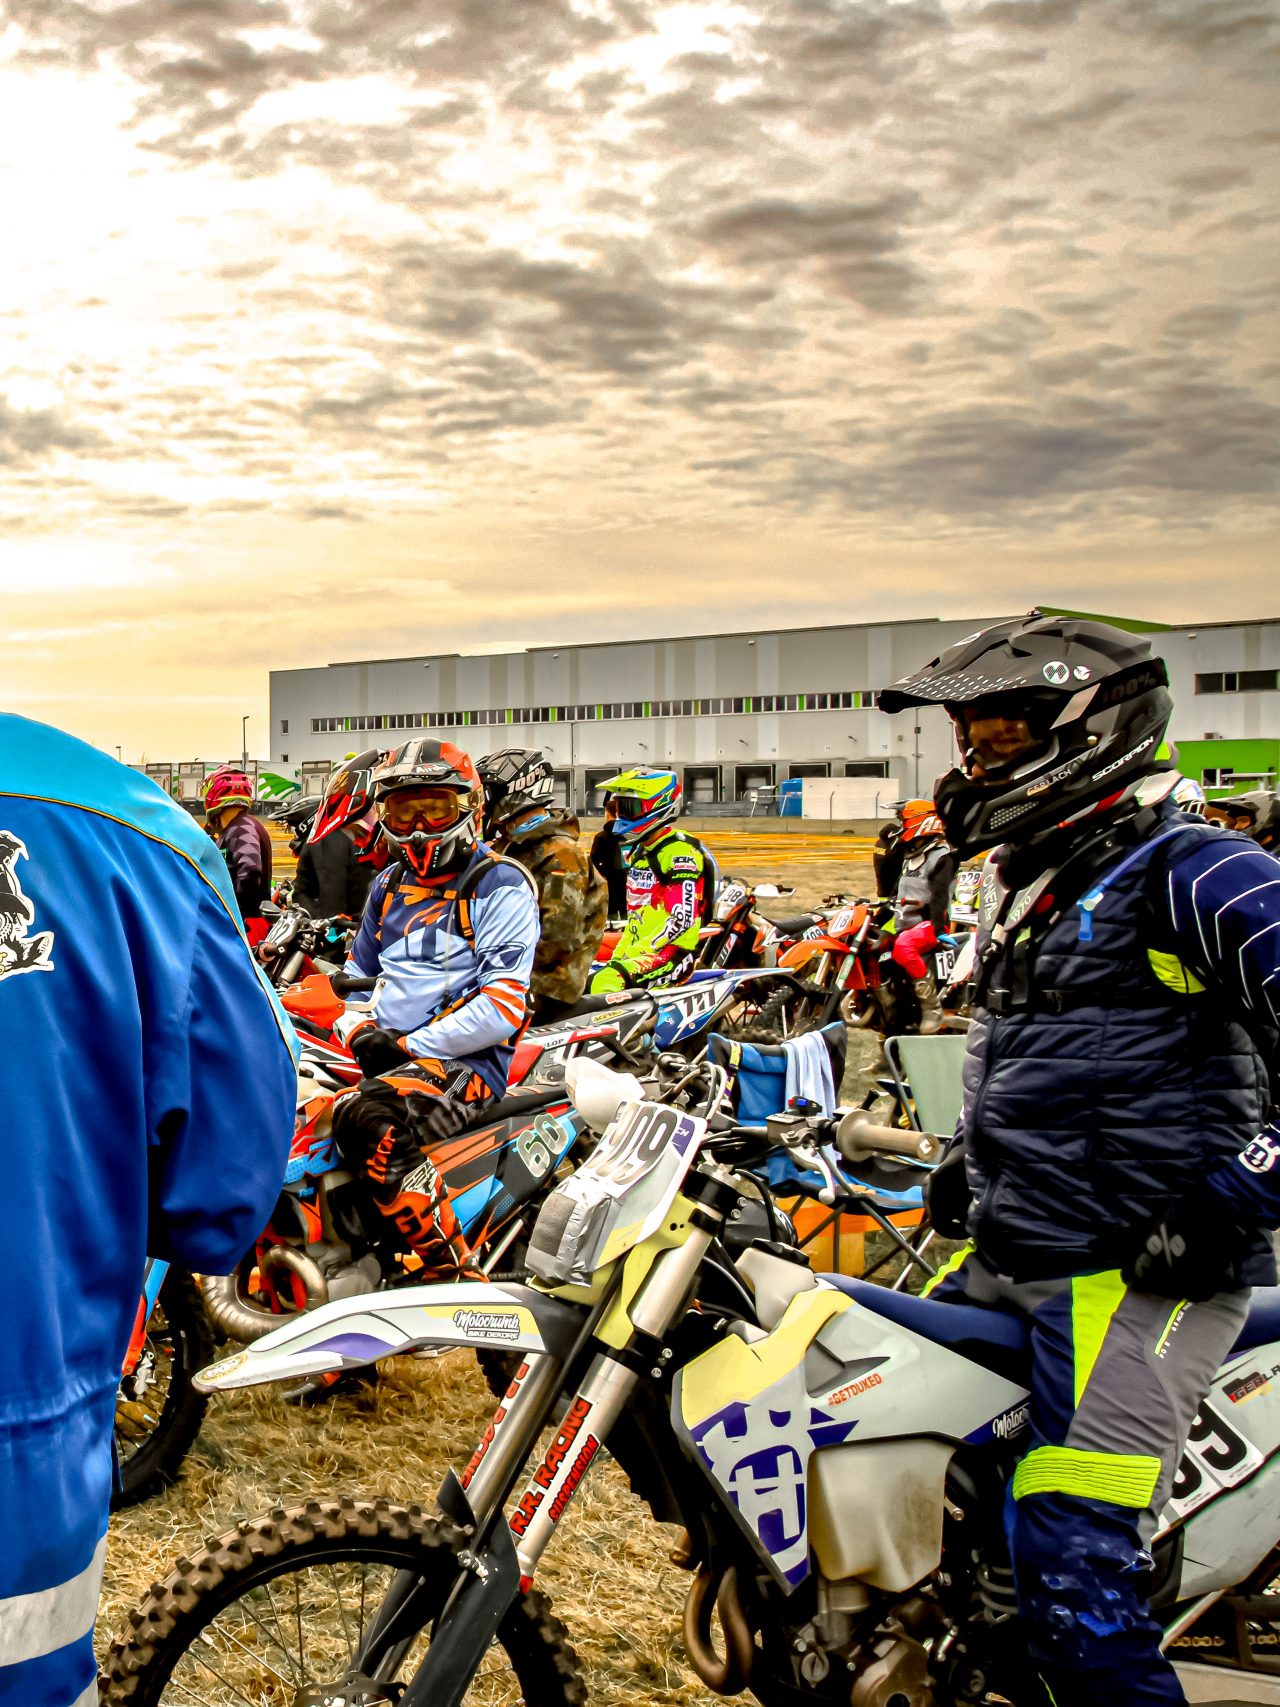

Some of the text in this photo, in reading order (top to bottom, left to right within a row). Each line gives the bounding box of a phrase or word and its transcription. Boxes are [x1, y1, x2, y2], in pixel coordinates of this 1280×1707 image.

[1091, 735, 1155, 783] SCORPION
[507, 764, 547, 795] 100%
[1026, 768, 1073, 797] GERLACH
[667, 909, 685, 941] AUTO
[516, 1113, 569, 1178] 60
[453, 1309, 520, 1333] Motocrumb
[486, 1331, 519, 1340] DEKORE
[827, 1373, 883, 1407] #GETDUKED
[509, 1395, 594, 1537] R.R. RACING
[548, 1433, 601, 1524] SUSPENSION
